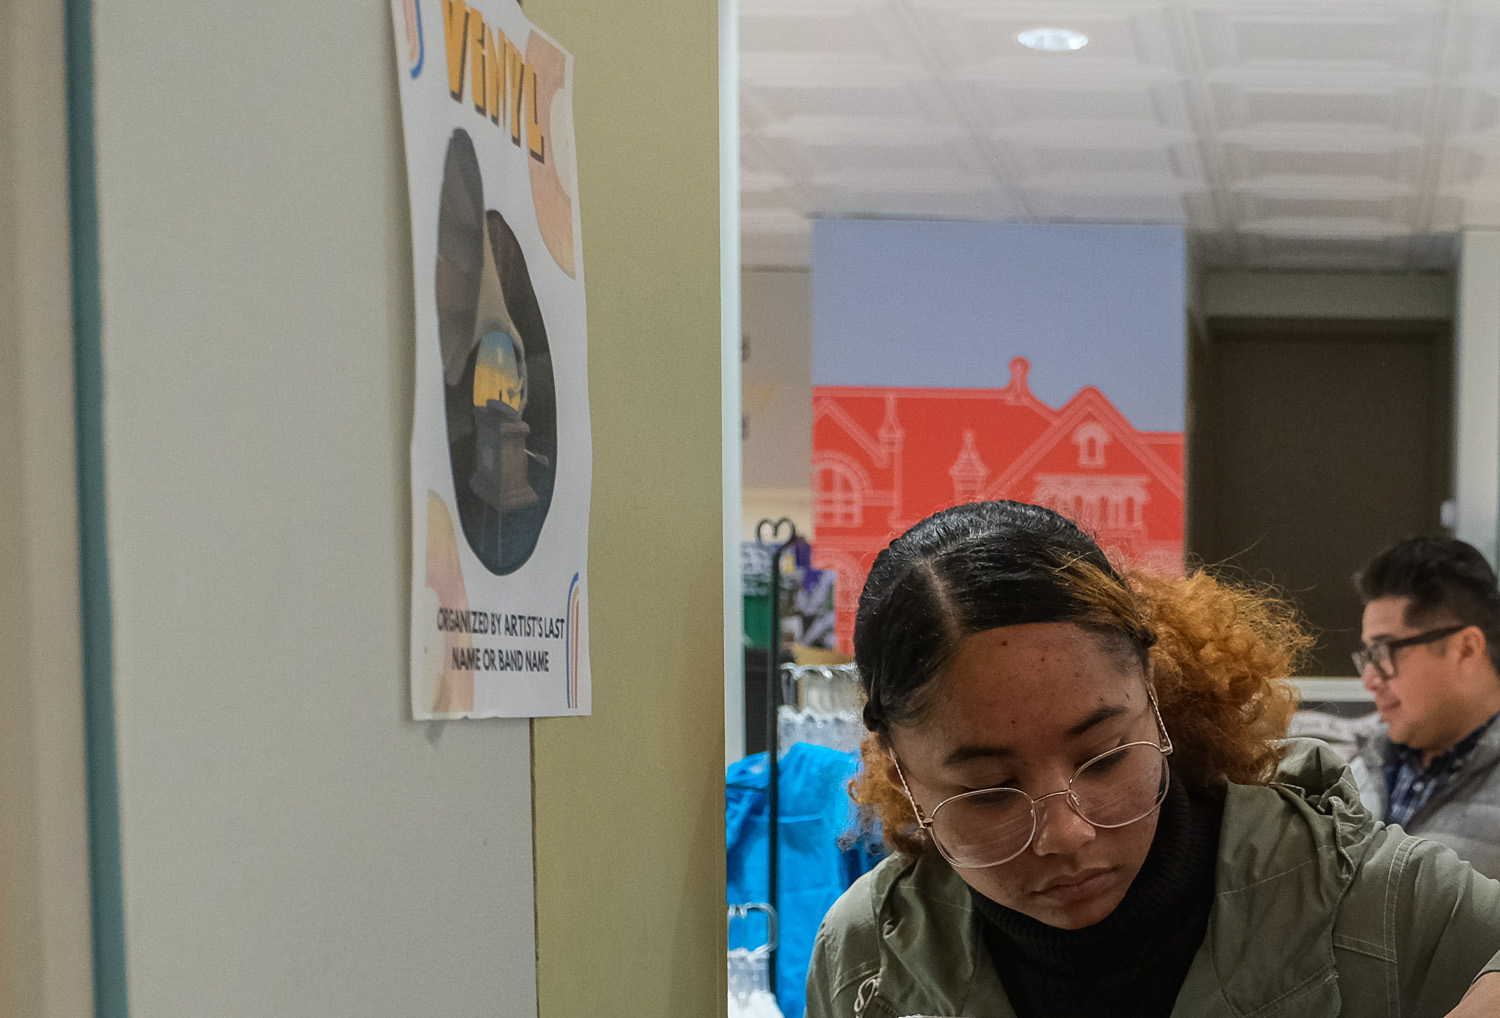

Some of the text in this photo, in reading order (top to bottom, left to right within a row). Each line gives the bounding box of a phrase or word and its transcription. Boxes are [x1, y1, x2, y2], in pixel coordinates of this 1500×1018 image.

[437, 607, 565, 640] ORGANIZED BY ARTIST'S LAST
[452, 646, 550, 673] NAME OR BAND NAME
